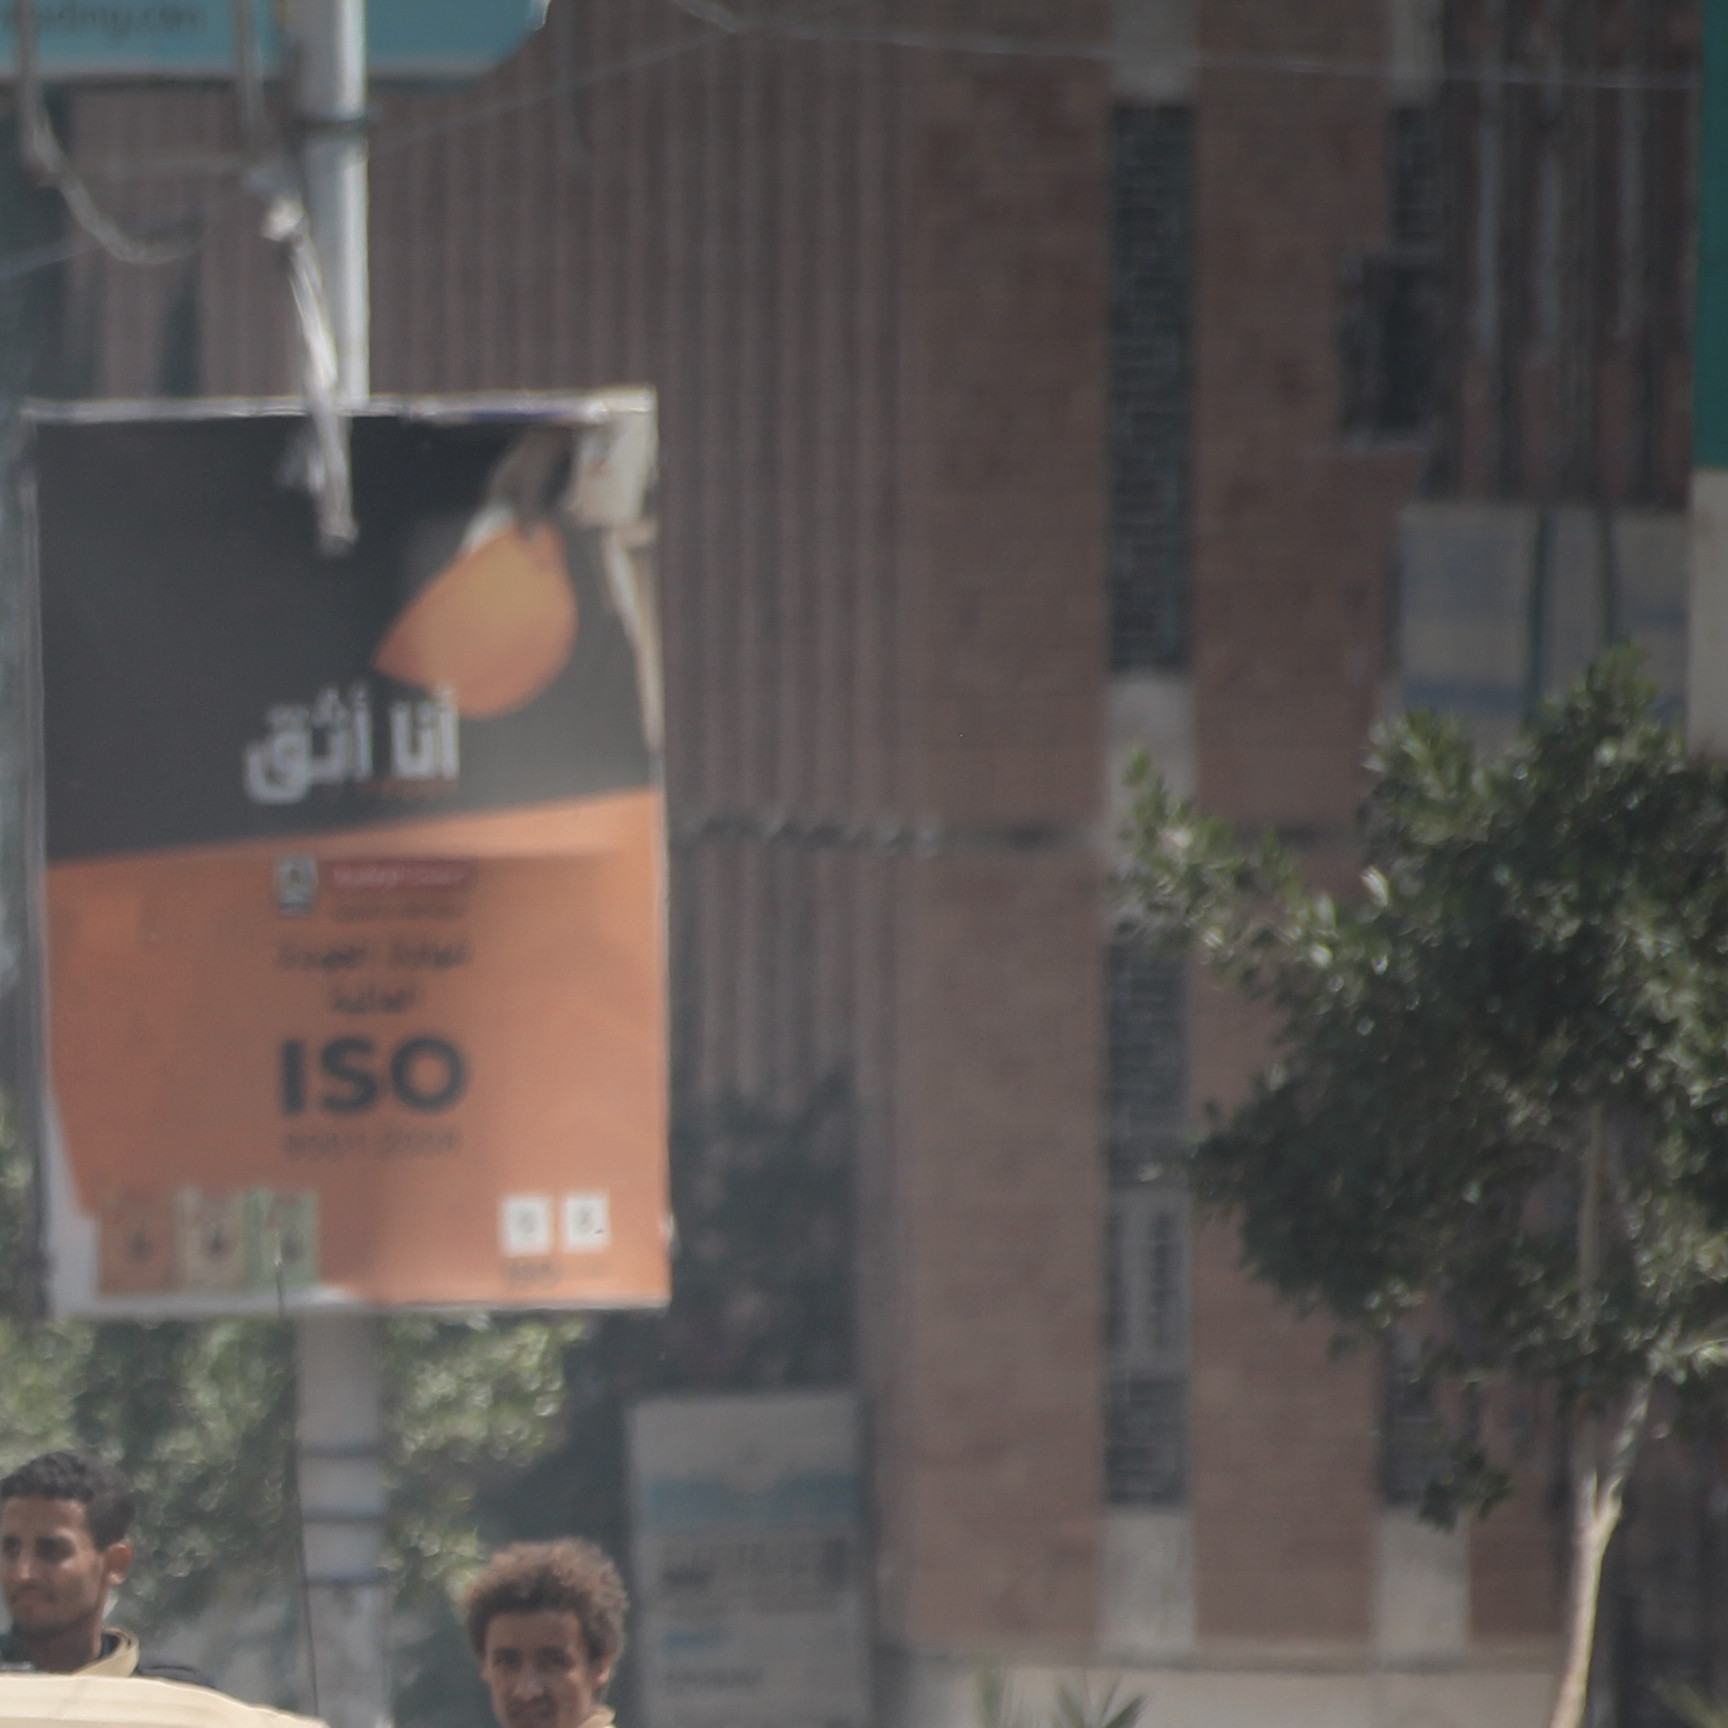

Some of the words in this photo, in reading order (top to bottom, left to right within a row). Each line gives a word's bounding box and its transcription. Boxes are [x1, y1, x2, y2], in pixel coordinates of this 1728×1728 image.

[244, 684, 374, 805] أثق
[390, 687, 460, 781] أنا
[282, 1035, 468, 1116] ISO
